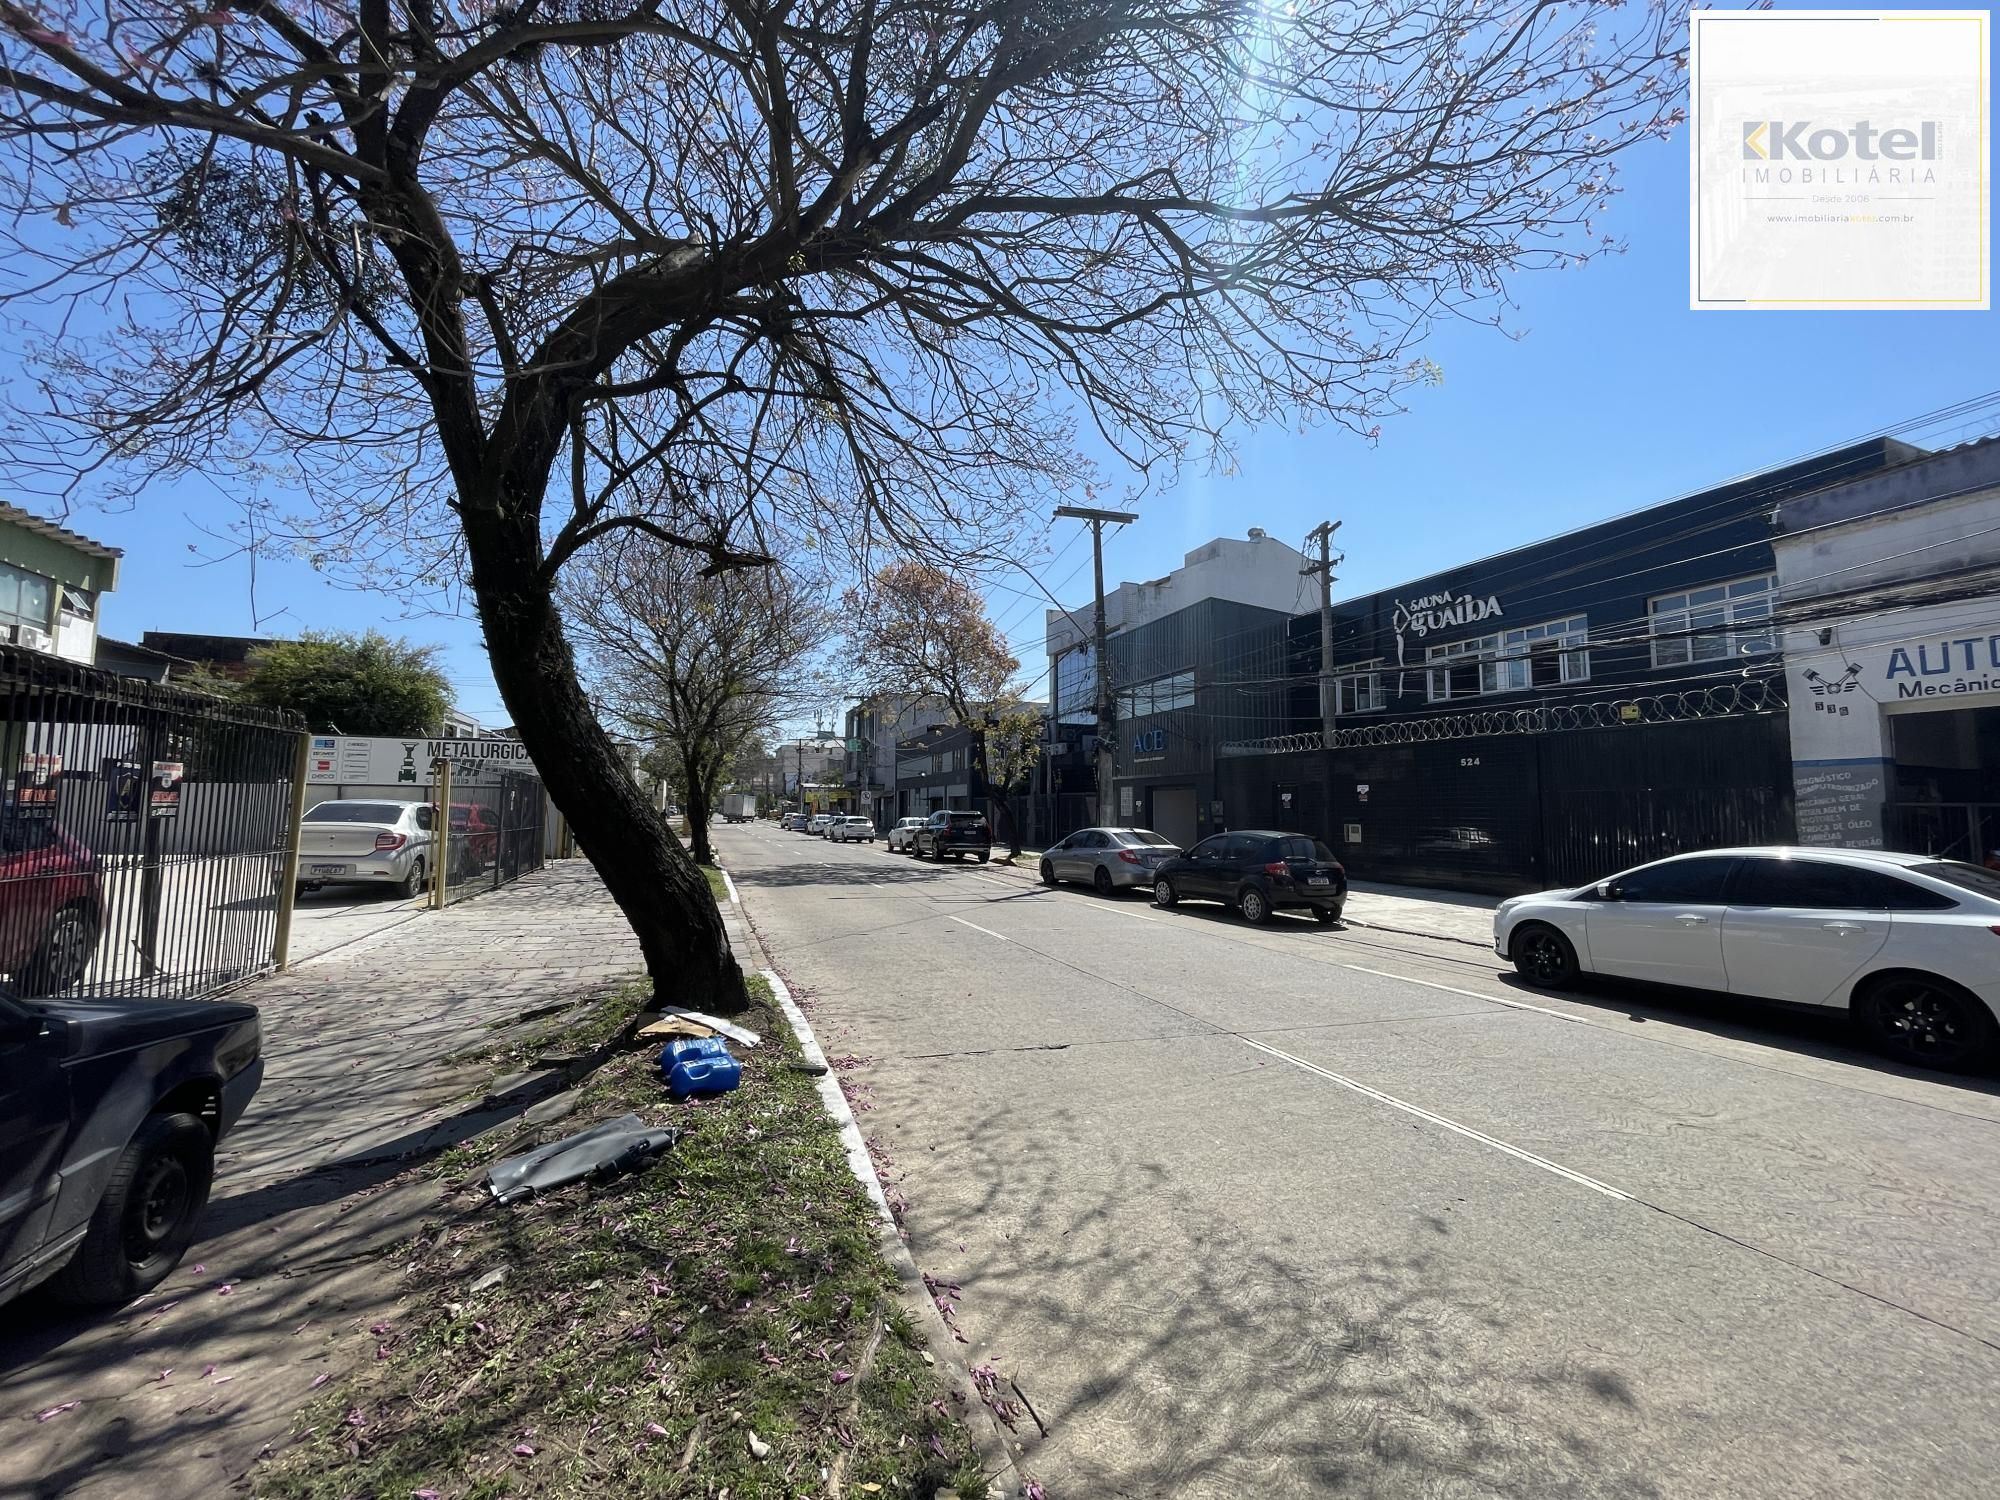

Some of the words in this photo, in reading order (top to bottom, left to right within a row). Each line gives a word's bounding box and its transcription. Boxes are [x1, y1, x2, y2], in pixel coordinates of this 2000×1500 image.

[1410, 590, 1453, 612] SAUNA
[1133, 730, 1164, 752] ACE
[1460, 757, 1480, 767] 524
